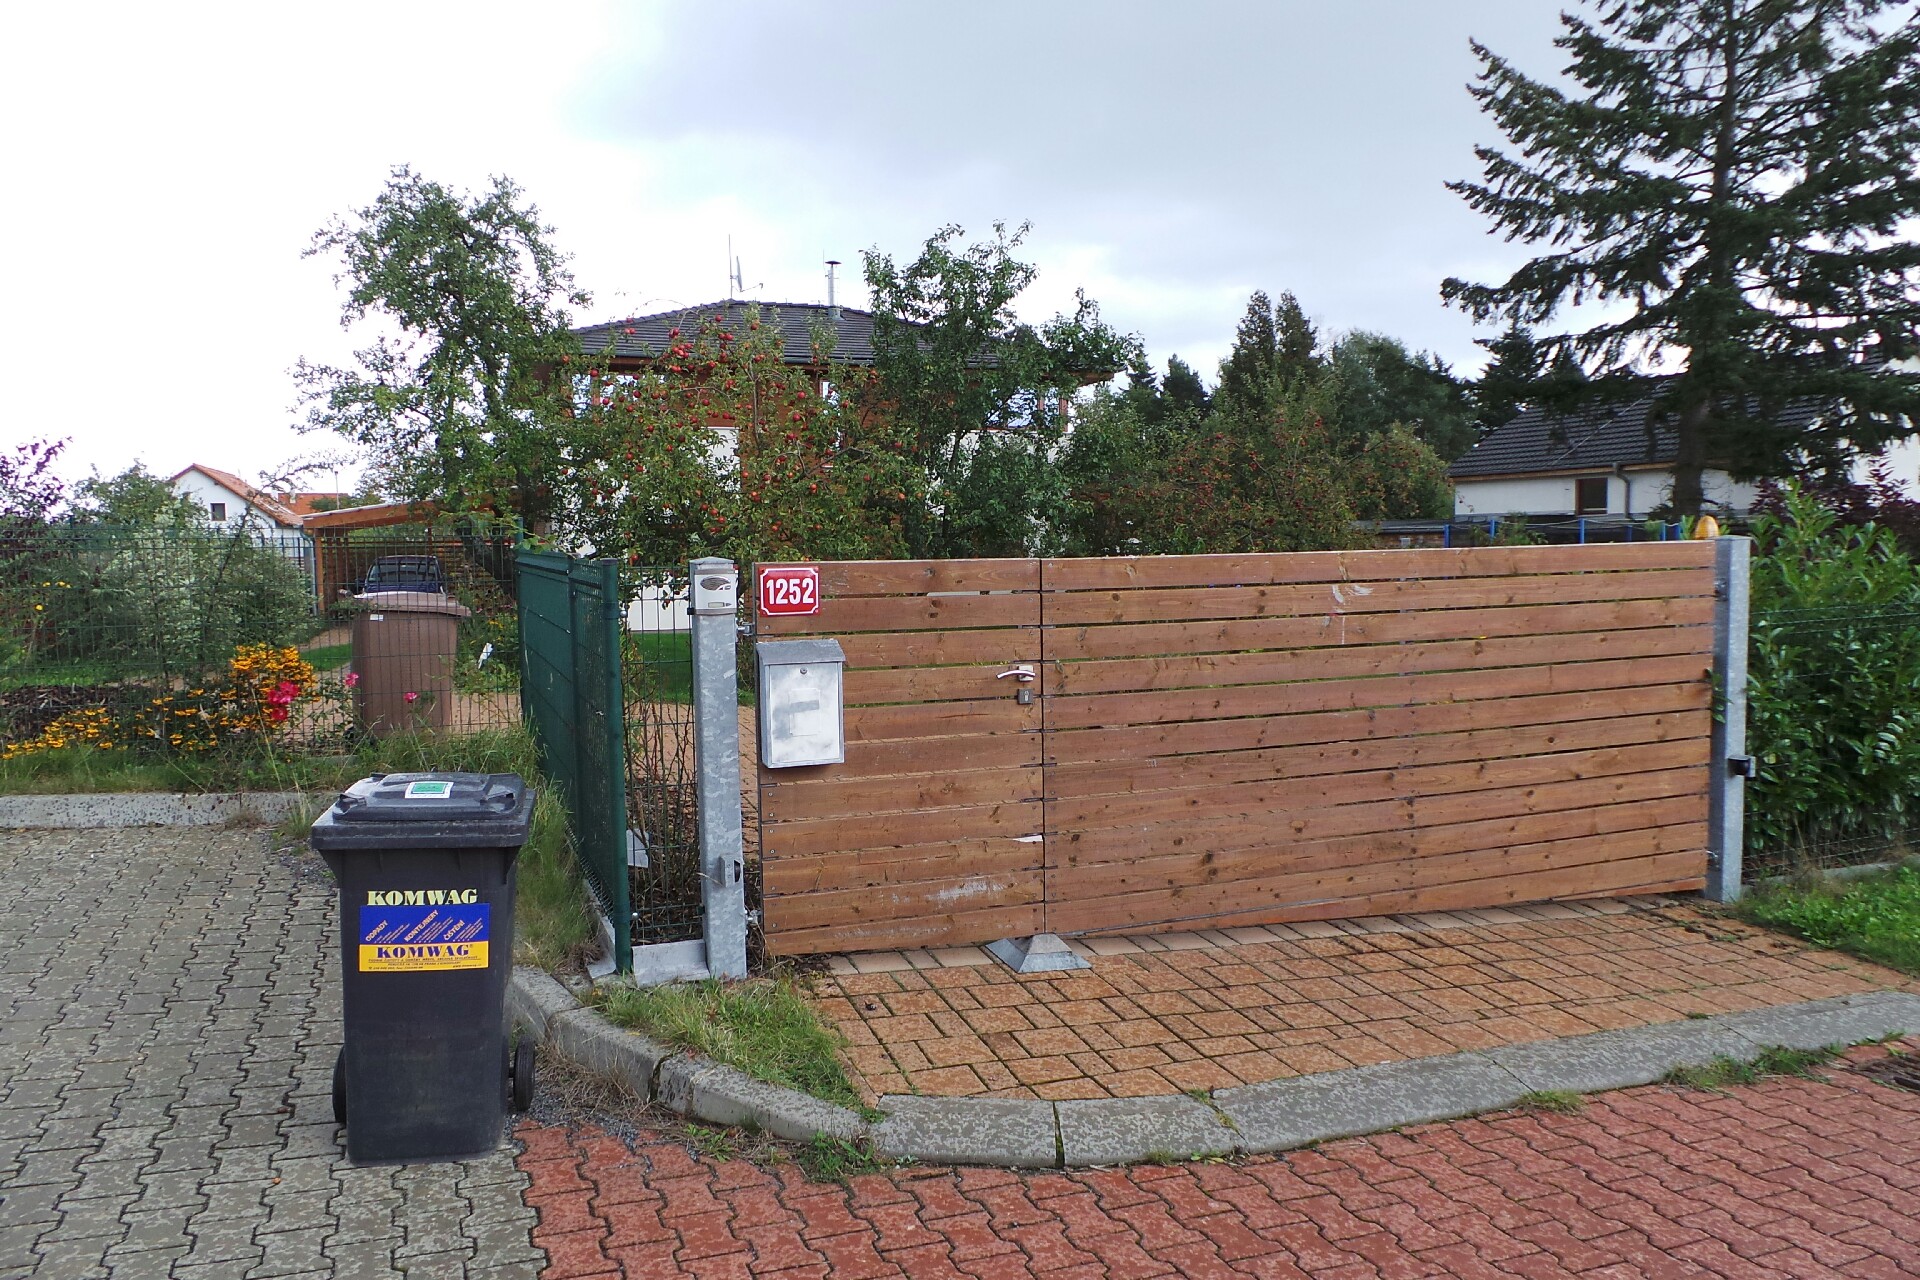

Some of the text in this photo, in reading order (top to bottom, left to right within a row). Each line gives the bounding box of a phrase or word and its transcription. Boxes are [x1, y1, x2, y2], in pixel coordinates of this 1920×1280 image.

[766, 577, 814, 605] 1252
[367, 889, 478, 906] KOMWAG
[365, 920, 388, 942] ODPADY
[404, 910, 439, 942] KONTEJNERY
[377, 945, 470, 959] KOMWAG
